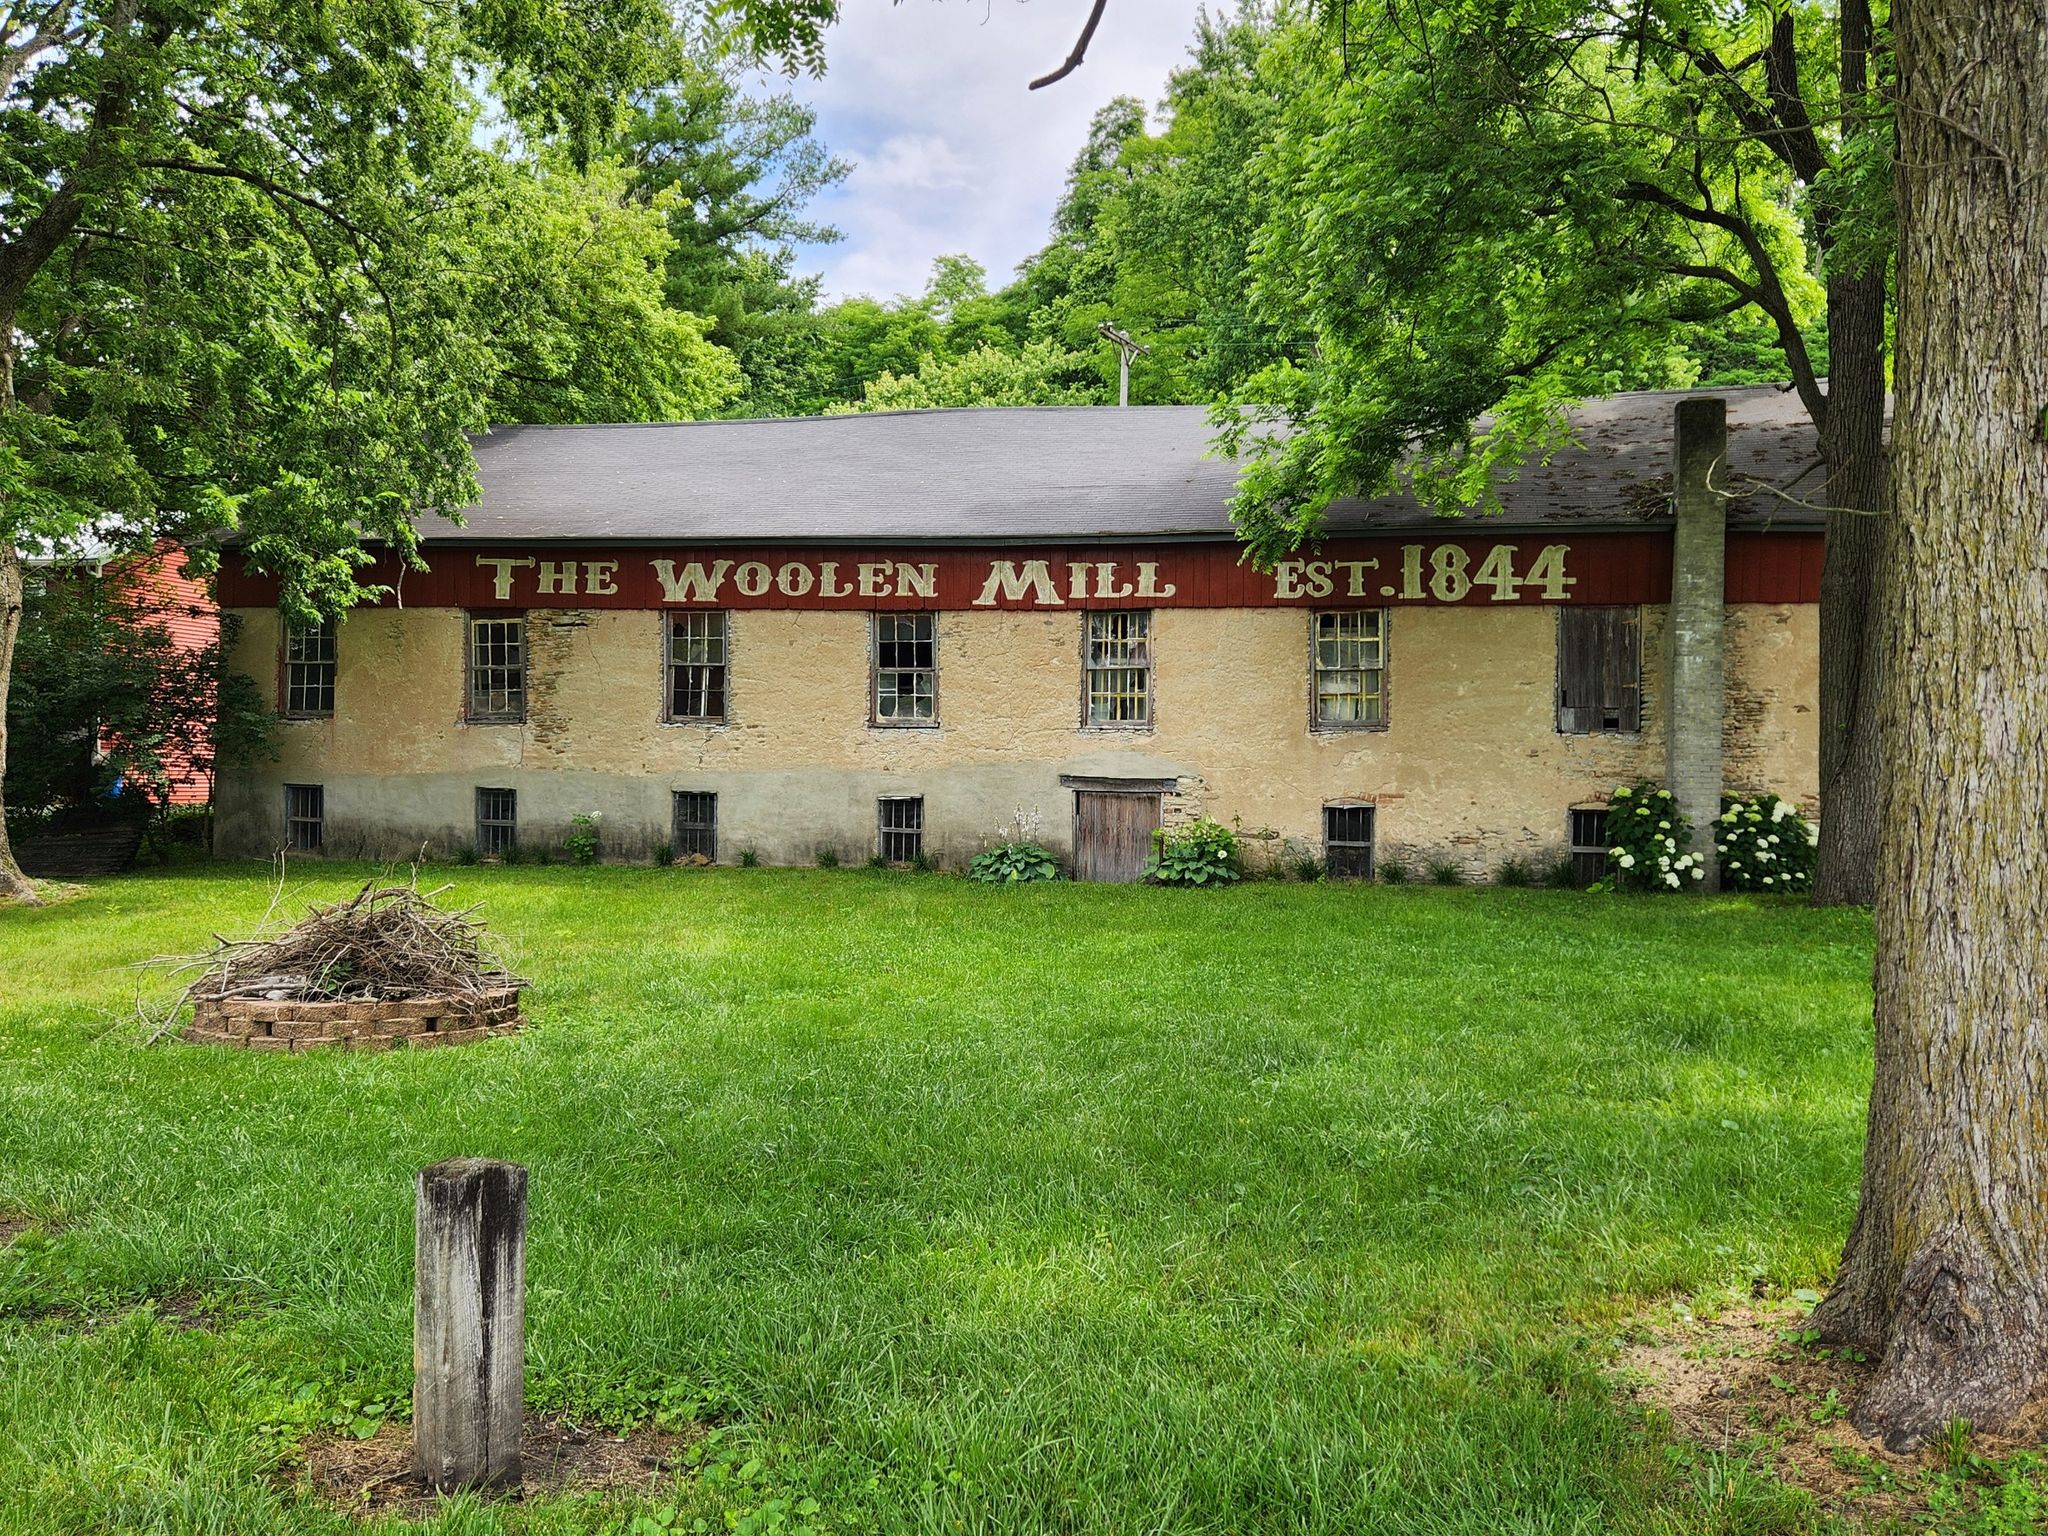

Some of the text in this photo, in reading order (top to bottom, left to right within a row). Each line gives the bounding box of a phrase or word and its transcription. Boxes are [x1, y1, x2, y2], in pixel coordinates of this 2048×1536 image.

[475, 553, 619, 600] THE
[648, 558, 939, 602] WOOLEN
[972, 559, 1177, 605] MILL
